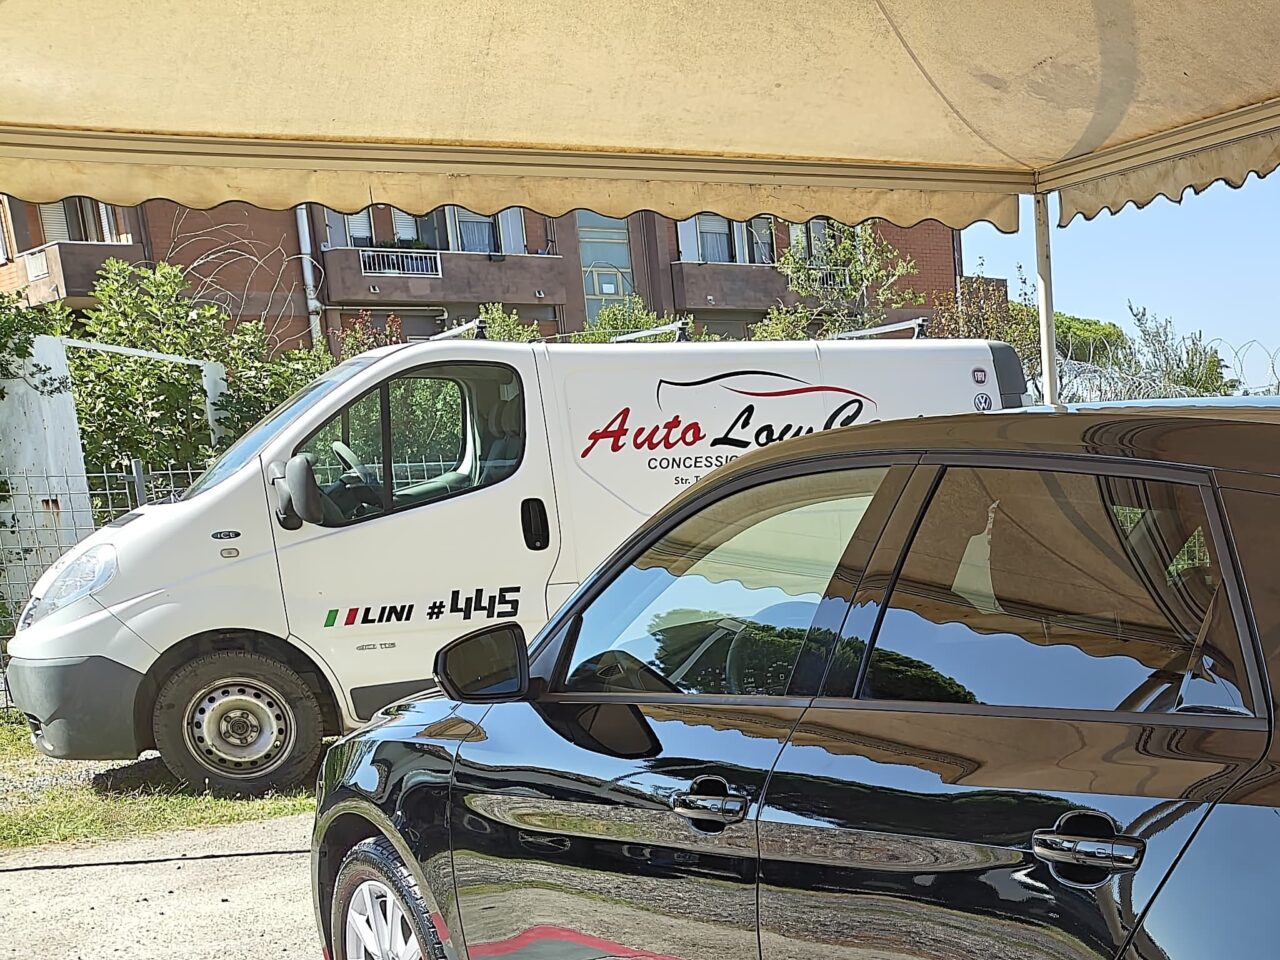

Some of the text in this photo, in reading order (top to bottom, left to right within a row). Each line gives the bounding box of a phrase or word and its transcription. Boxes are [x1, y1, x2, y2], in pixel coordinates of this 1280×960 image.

[580, 406, 706, 458] Auto
[674, 476, 691, 485] Str.
[361, 586, 522, 625] LINI #445
